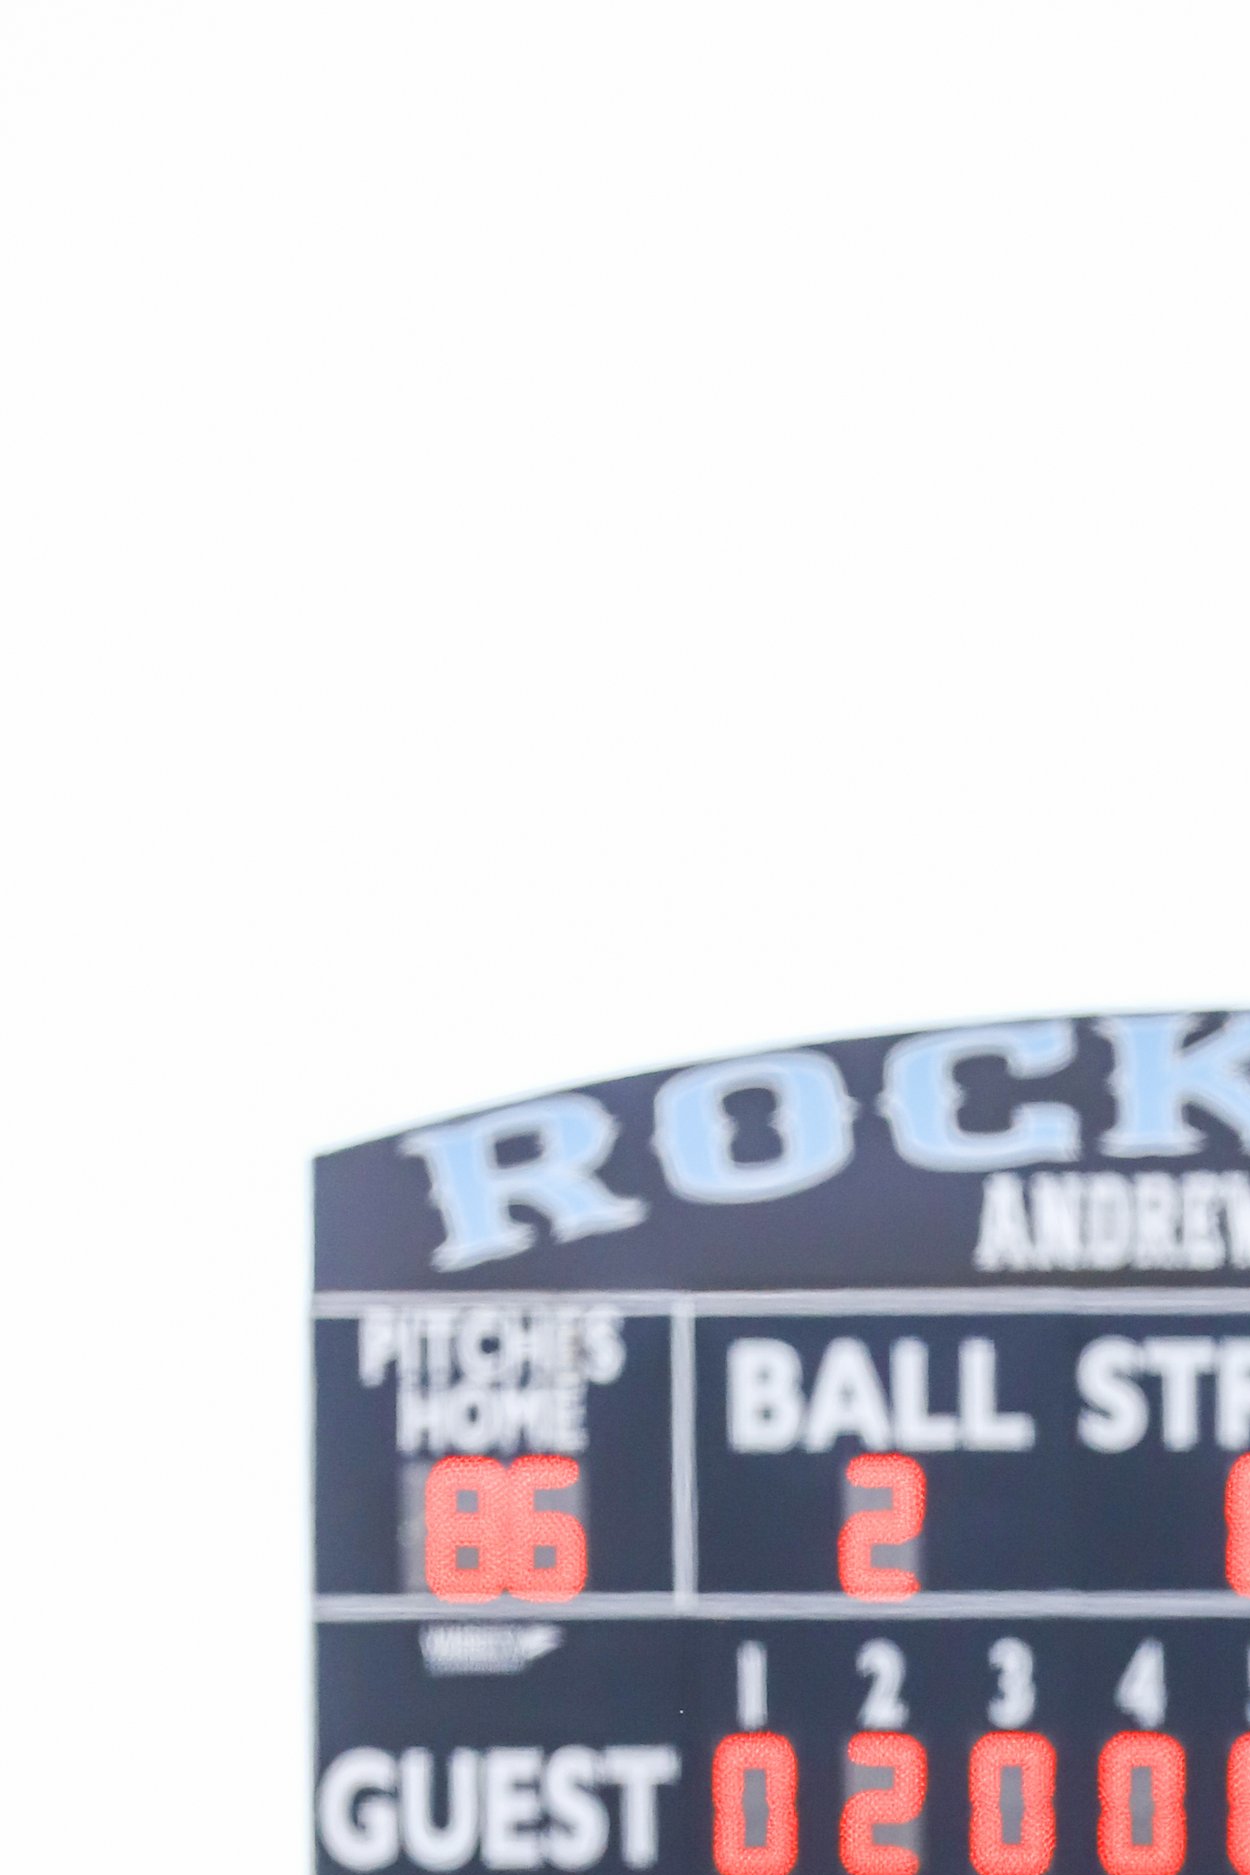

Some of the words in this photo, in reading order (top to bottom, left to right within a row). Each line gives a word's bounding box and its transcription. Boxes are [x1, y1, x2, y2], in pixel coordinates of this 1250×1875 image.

[358, 1306, 625, 1386] PITCHES
[727, 1336, 1036, 1453] BALL
[397, 1382, 589, 1454] HOME
[425, 1454, 588, 1602] 86
[838, 1452, 927, 1600] 2
[735, 1639, 768, 1730] 1
[856, 1638, 908, 1729] 2
[987, 1638, 1037, 1728] 3
[1115, 1637, 1166, 1728] 4
[318, 1745, 682, 1871] GUEST
